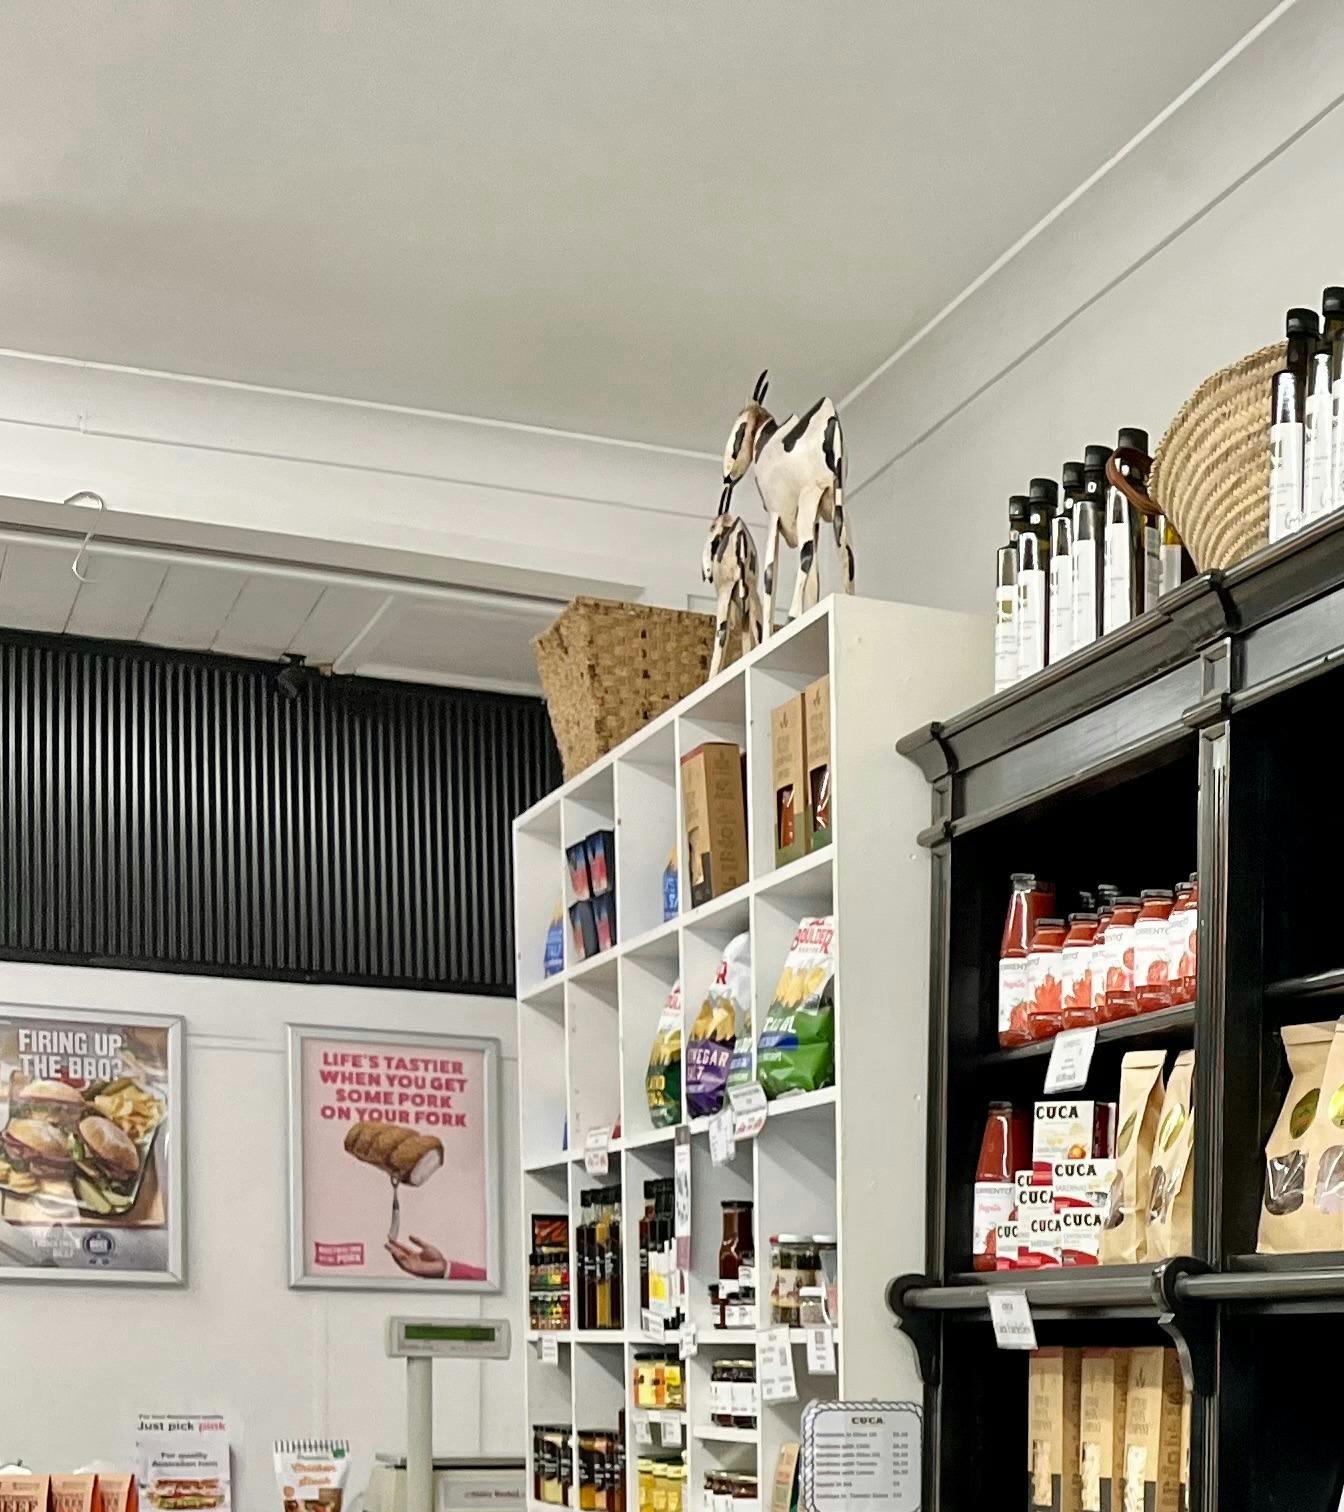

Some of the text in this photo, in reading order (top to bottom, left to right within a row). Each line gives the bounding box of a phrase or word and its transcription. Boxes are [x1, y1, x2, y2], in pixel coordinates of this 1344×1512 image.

[791, 927, 834, 954] BOULDER
[18, 1029, 123, 1057] FIRING UP
[20, 1055, 124, 1082] THE BBQ?
[322, 1052, 464, 1075] LIFE'S TASTIER
[319, 1070, 468, 1093] WHEN YOU GET
[336, 1088, 452, 1109] SOME PORK
[320, 1105, 467, 1128] ON YOUR FORK
[1036, 1105, 1079, 1120] CUCA
[1054, 1163, 1097, 1177] CUCA
[1031, 1219, 1061, 1233] CUCA
[1063, 1213, 1102, 1227] CUCA
[137, 1421, 164, 1432] Just
[168, 1420, 195, 1432] pick
[851, 1416, 884, 1425] CUCA
